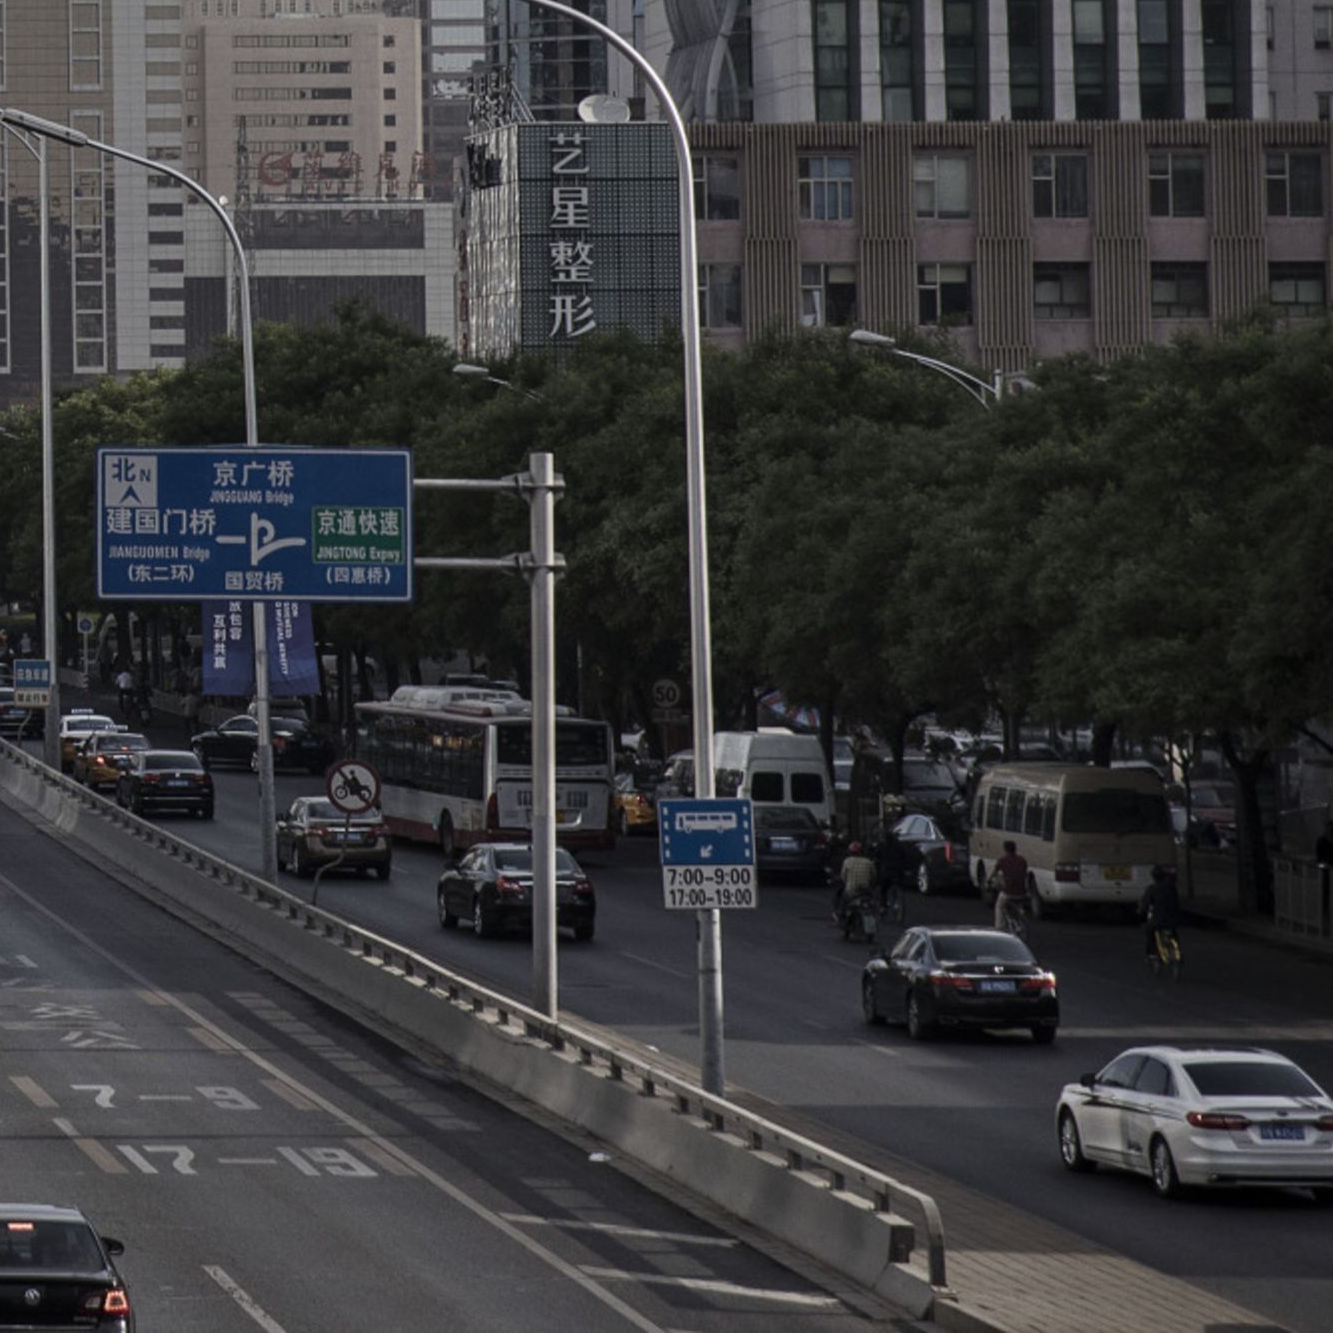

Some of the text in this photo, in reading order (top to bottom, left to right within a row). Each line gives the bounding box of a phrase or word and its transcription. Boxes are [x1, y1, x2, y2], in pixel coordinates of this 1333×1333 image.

[547, 132, 597, 339] 艺星整形
[112, 458, 136, 482] 北
[139, 469, 151, 482] N
[212, 460, 295, 488] 京广桥
[209, 490, 295, 506] JINGGUANG Bridge
[106, 508, 217, 536] 建国门桥
[317, 510, 401, 537] 京通快速
[108, 546, 211, 563] JIANGUOMEN Bridge
[317, 546, 401, 564] JINGTONG Expwy
[224, 570, 285, 592] 国贸桥
[667, 868, 751, 886] 7:00-9:00
[669, 888, 752, 906] 17:00-19:00
